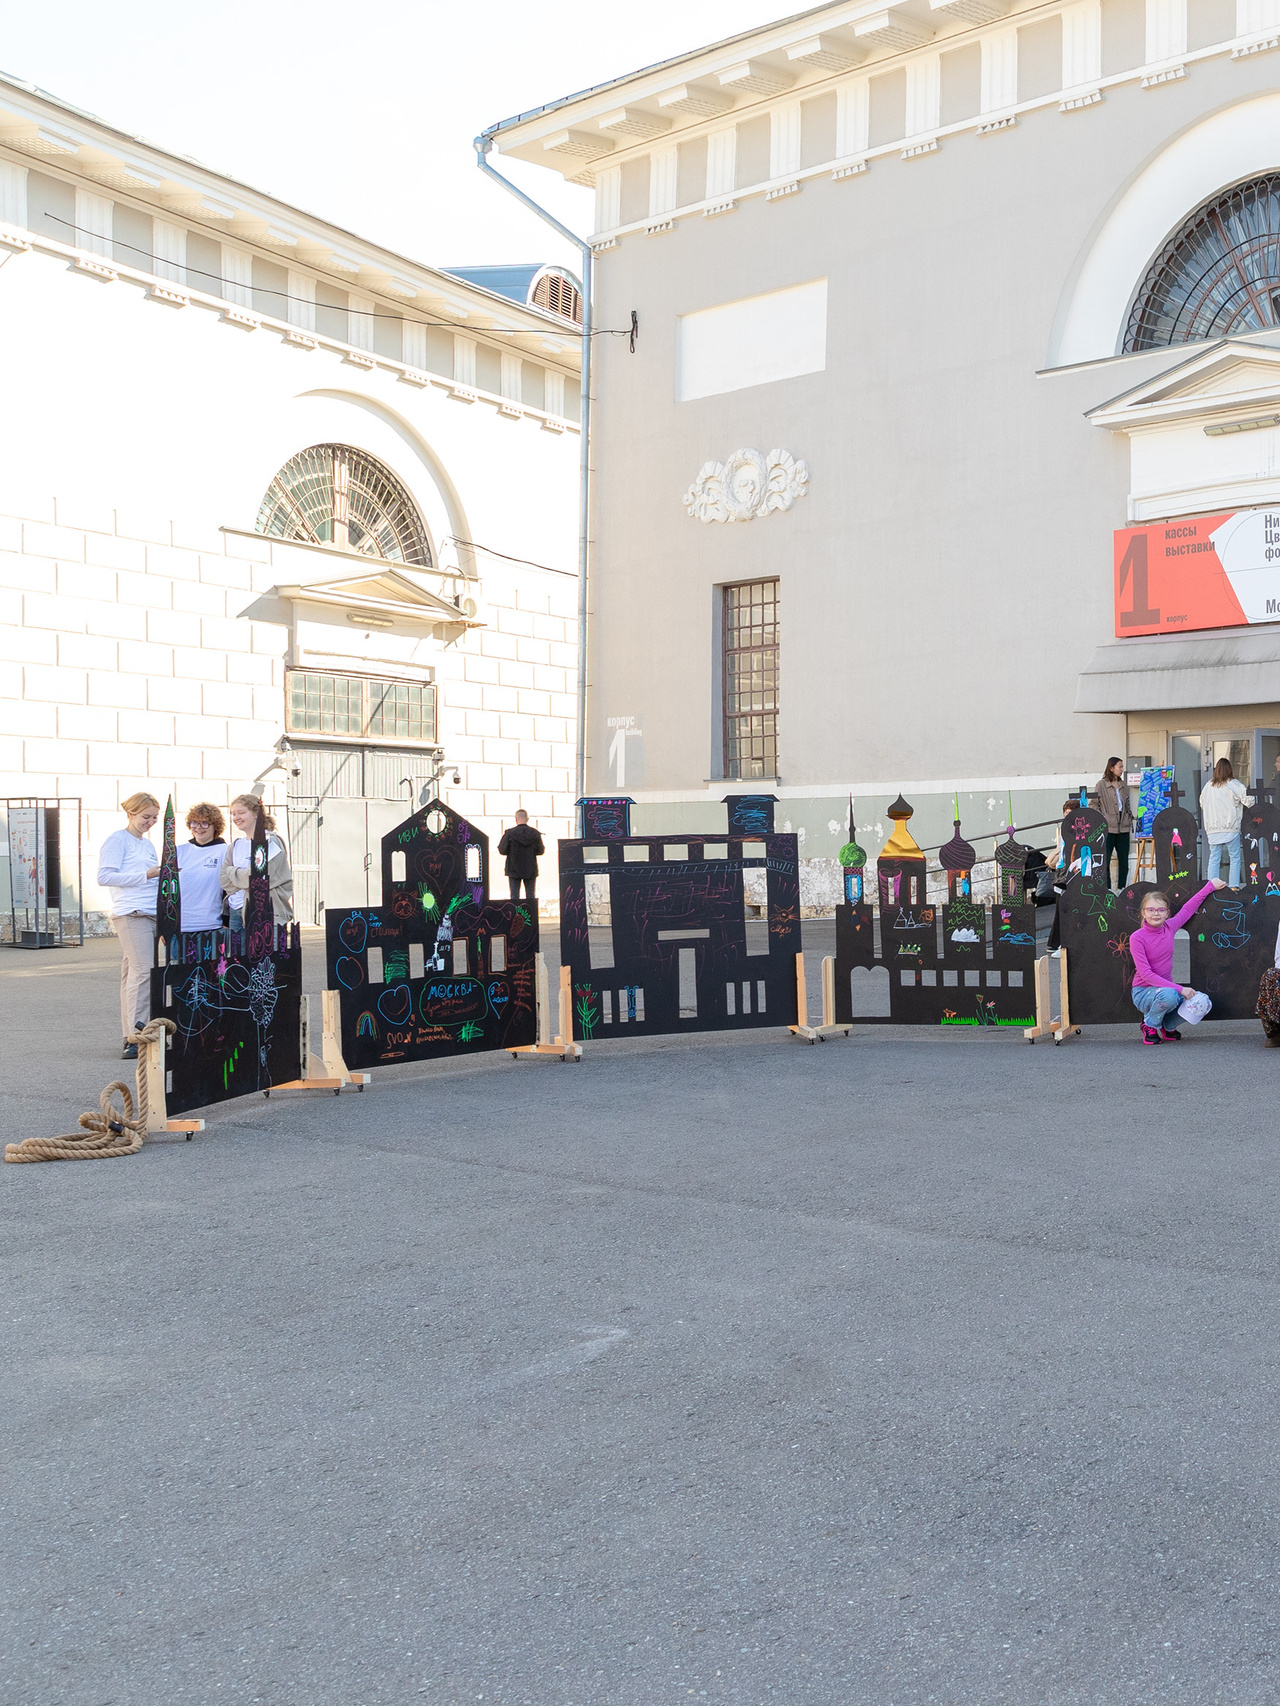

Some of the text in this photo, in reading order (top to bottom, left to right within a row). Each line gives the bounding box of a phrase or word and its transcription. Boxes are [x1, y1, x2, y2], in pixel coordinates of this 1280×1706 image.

[1165, 526, 1197, 540] кассы
[1165, 541, 1216, 557] выставки
[1119, 533, 1161, 628] 1
[1166, 614, 1188, 624] корпус
[607, 716, 635, 728] корпус
[609, 729, 626, 787] 1
